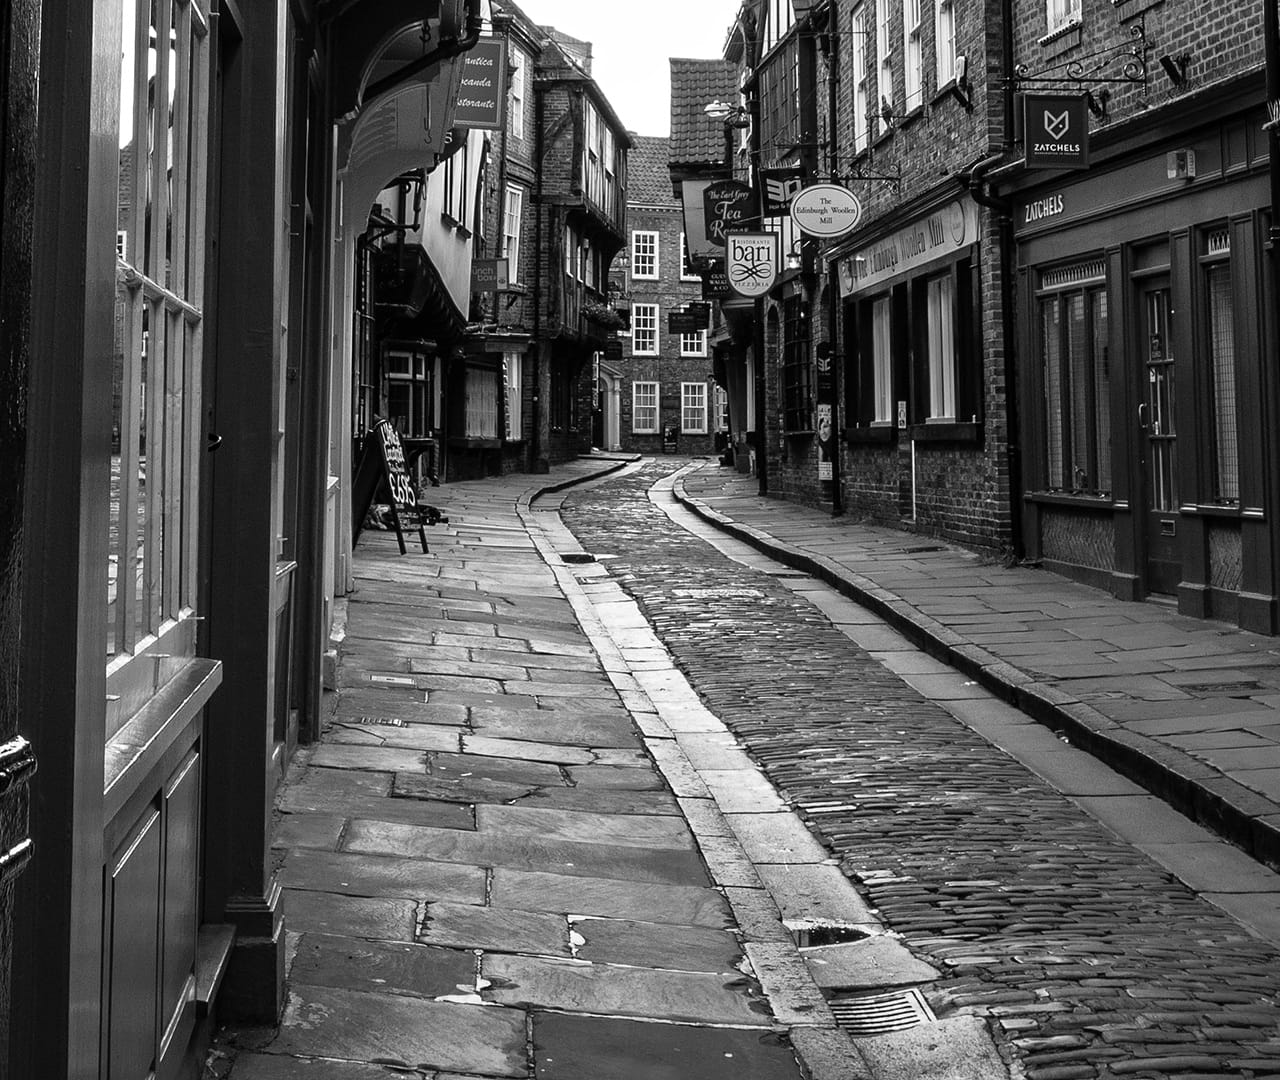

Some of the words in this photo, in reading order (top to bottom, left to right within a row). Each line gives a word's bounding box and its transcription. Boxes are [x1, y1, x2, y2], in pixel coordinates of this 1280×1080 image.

[1034, 143, 1080, 151] ZATCHELS
[708, 190, 720, 199] The
[714, 199, 742, 220] Tea
[797, 207, 828, 215] Edinburgh
[1025, 194, 1064, 222] ZATCHELS
[731, 239, 771, 262] bari
